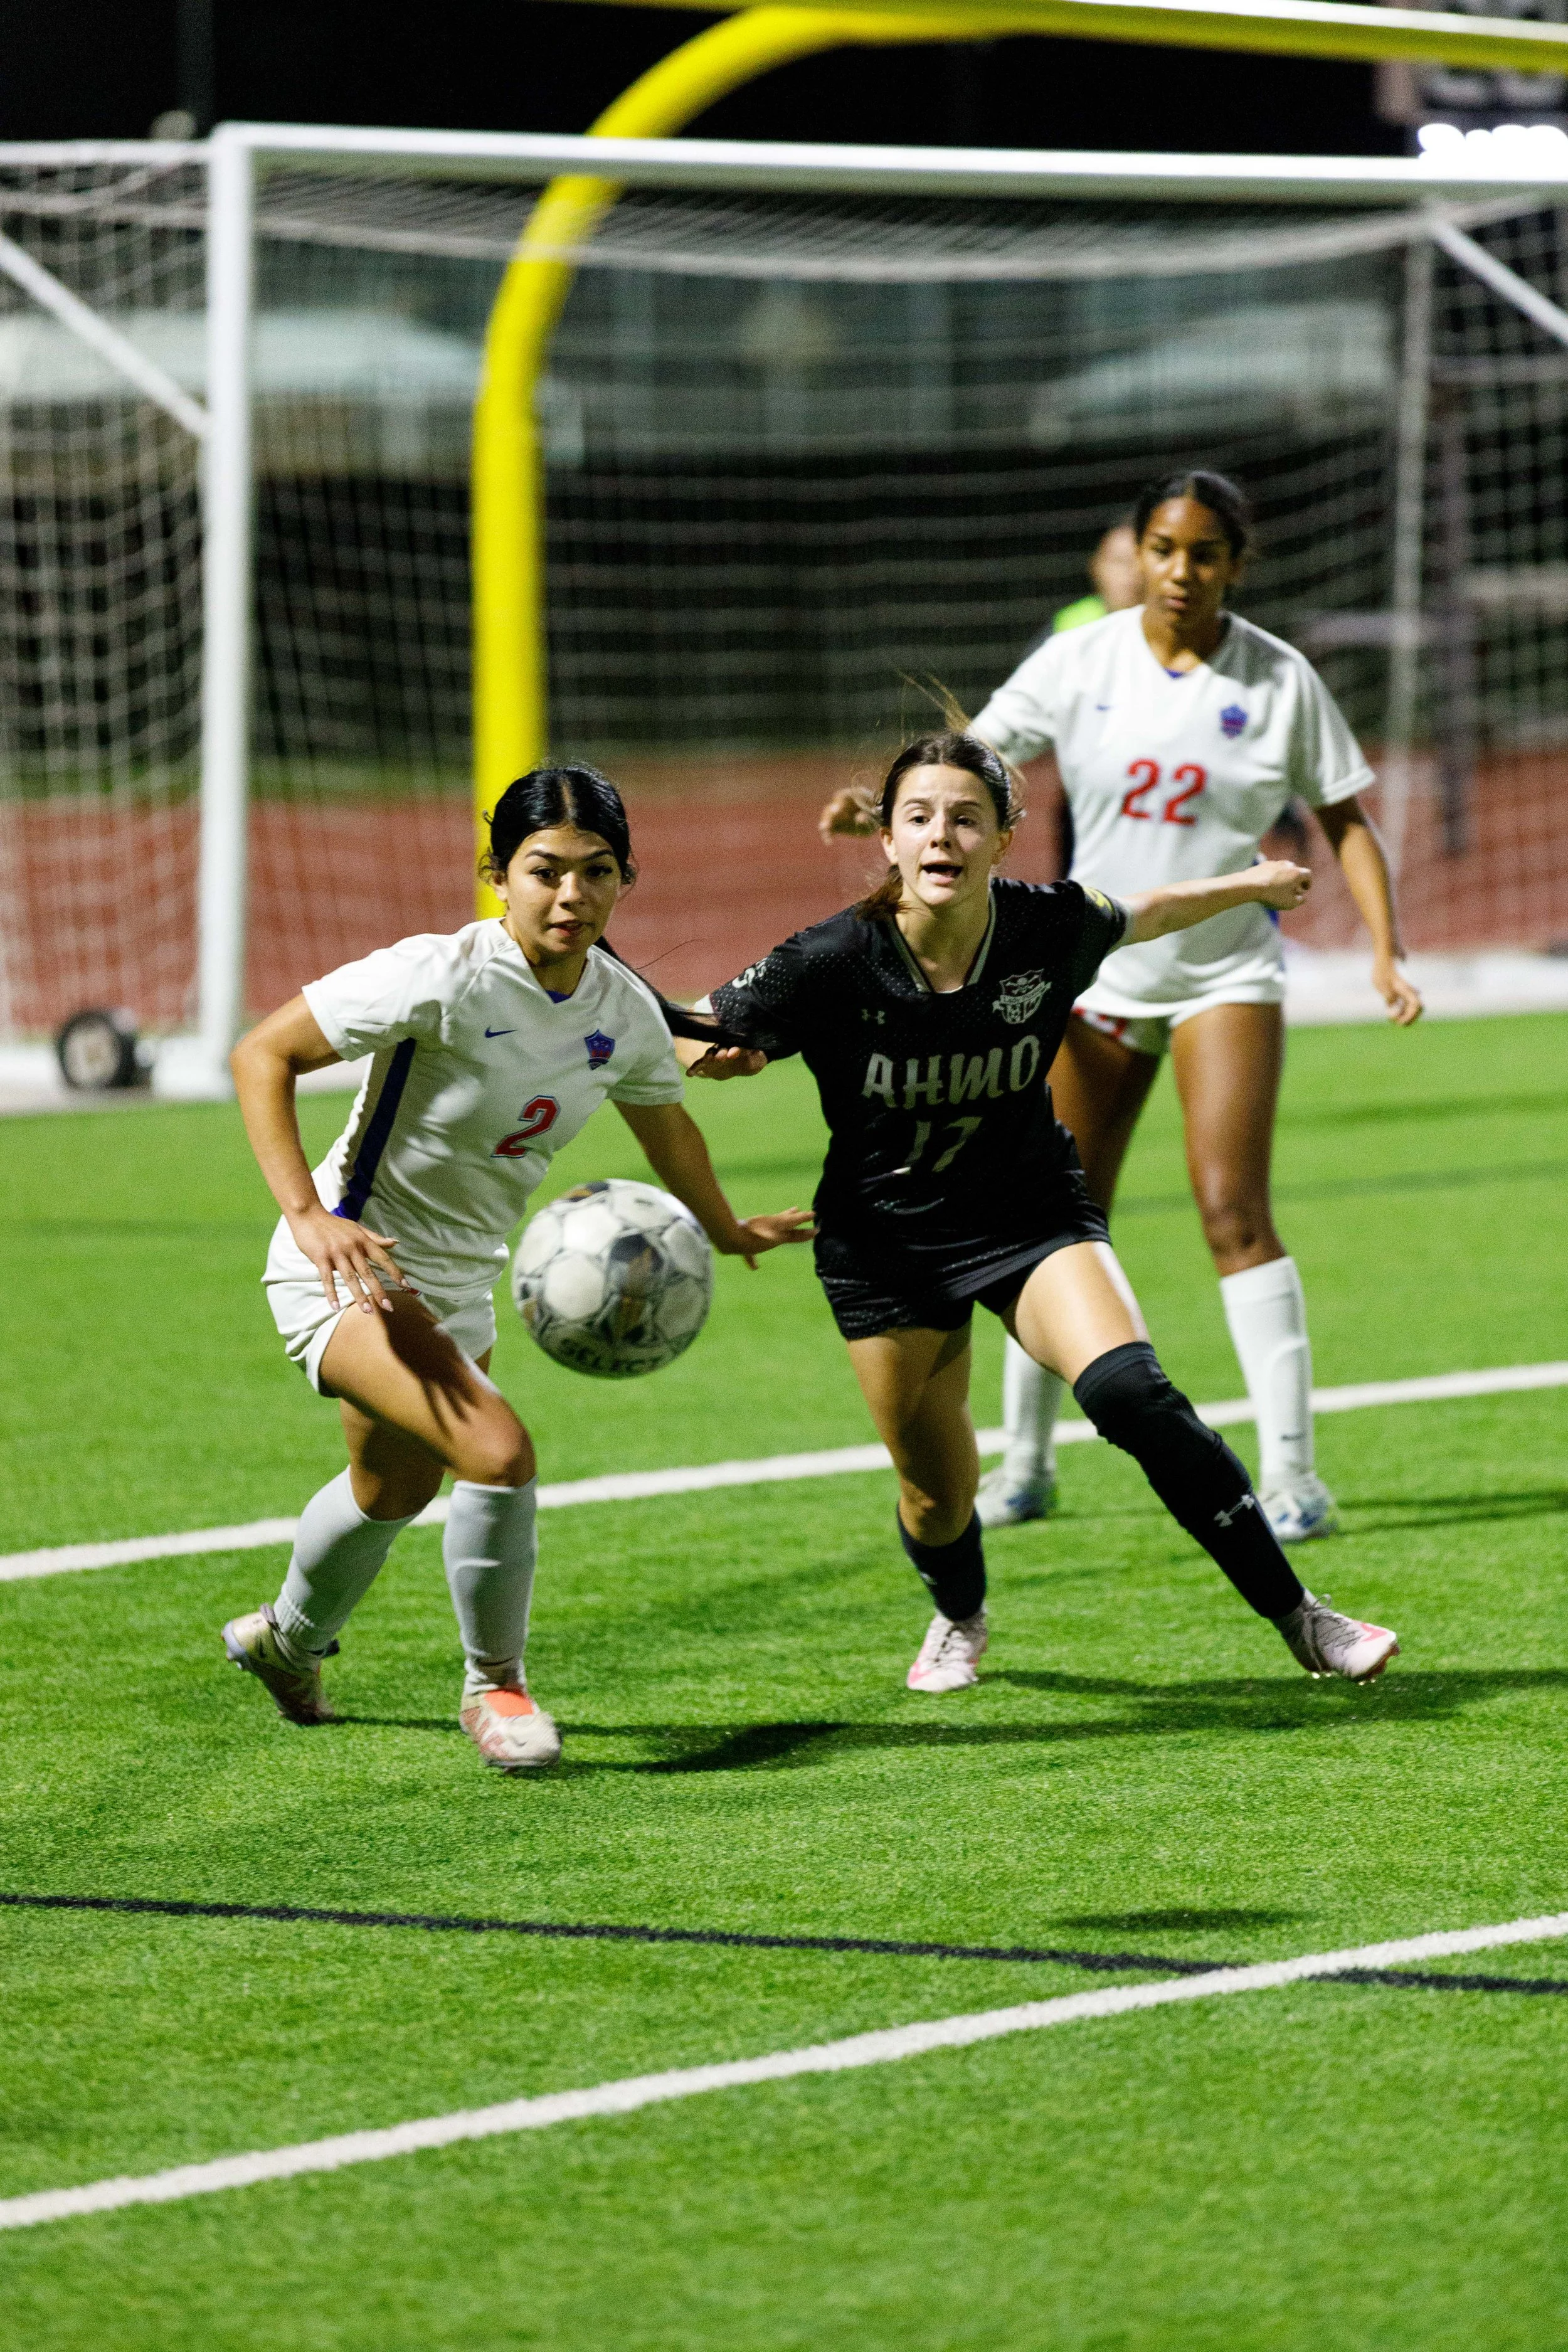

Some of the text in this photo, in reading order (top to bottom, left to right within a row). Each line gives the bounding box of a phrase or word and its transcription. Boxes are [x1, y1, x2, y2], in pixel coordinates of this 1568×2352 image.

[1121, 758, 1207, 827] 22
[861, 1034, 1040, 1109] AHMO
[490, 1094, 561, 1158] 2
[901, 1116, 983, 1173] 17
